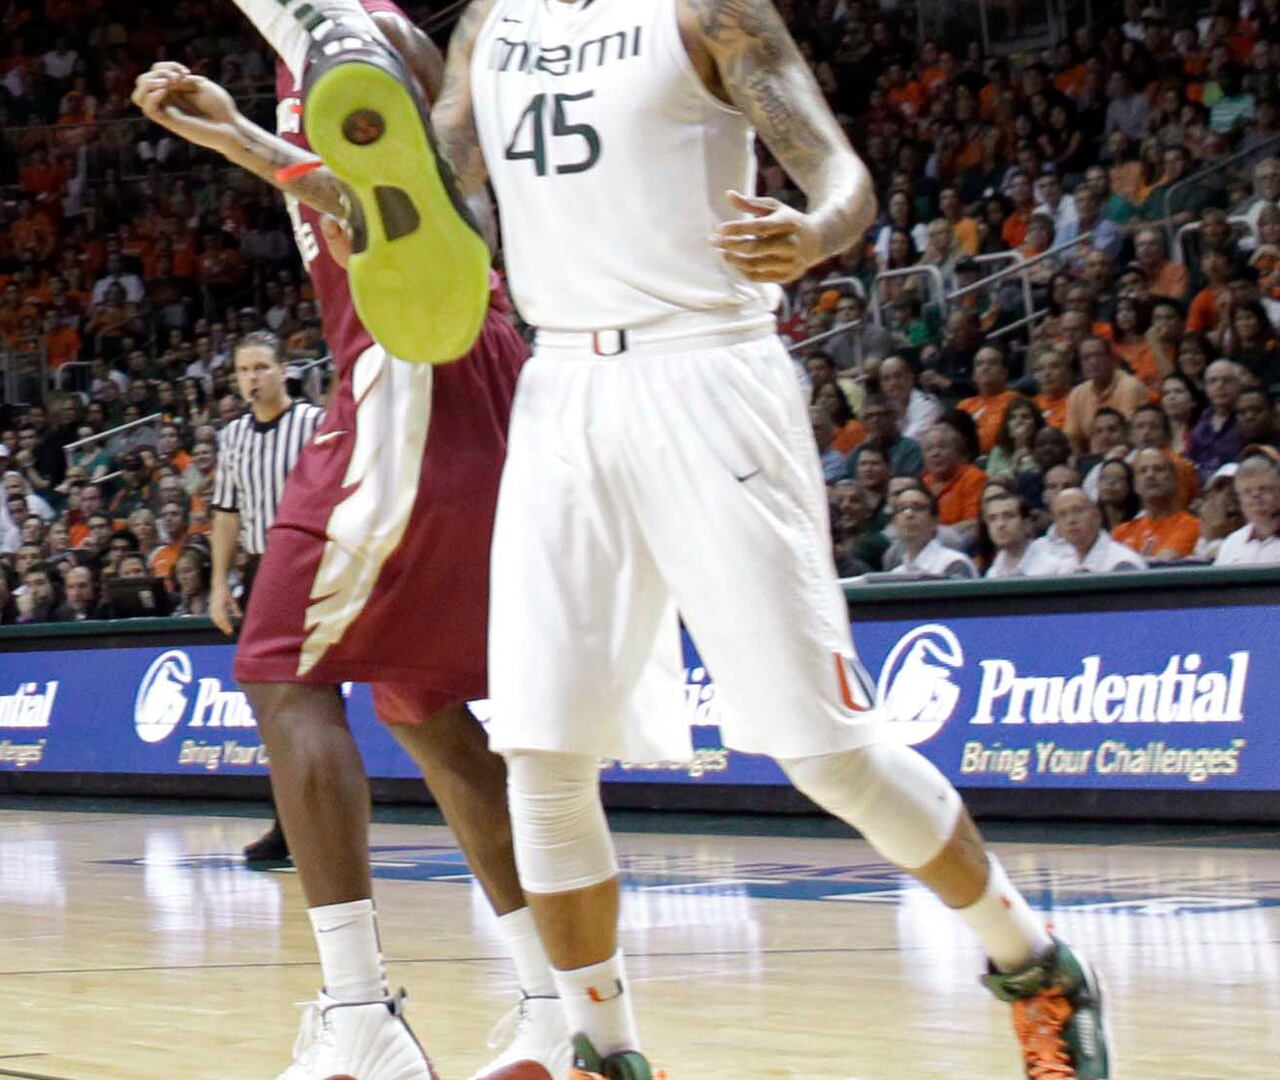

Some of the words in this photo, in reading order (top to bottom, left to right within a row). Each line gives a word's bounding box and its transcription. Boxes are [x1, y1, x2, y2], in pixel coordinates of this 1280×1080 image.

[504, 89, 602, 177] 45
[969, 650, 1250, 724] Prudential
[177, 740, 222, 769] Bring
[222, 741, 260, 764] Your
[960, 740, 1029, 781] Bring
[1036, 740, 1093, 774] Your
